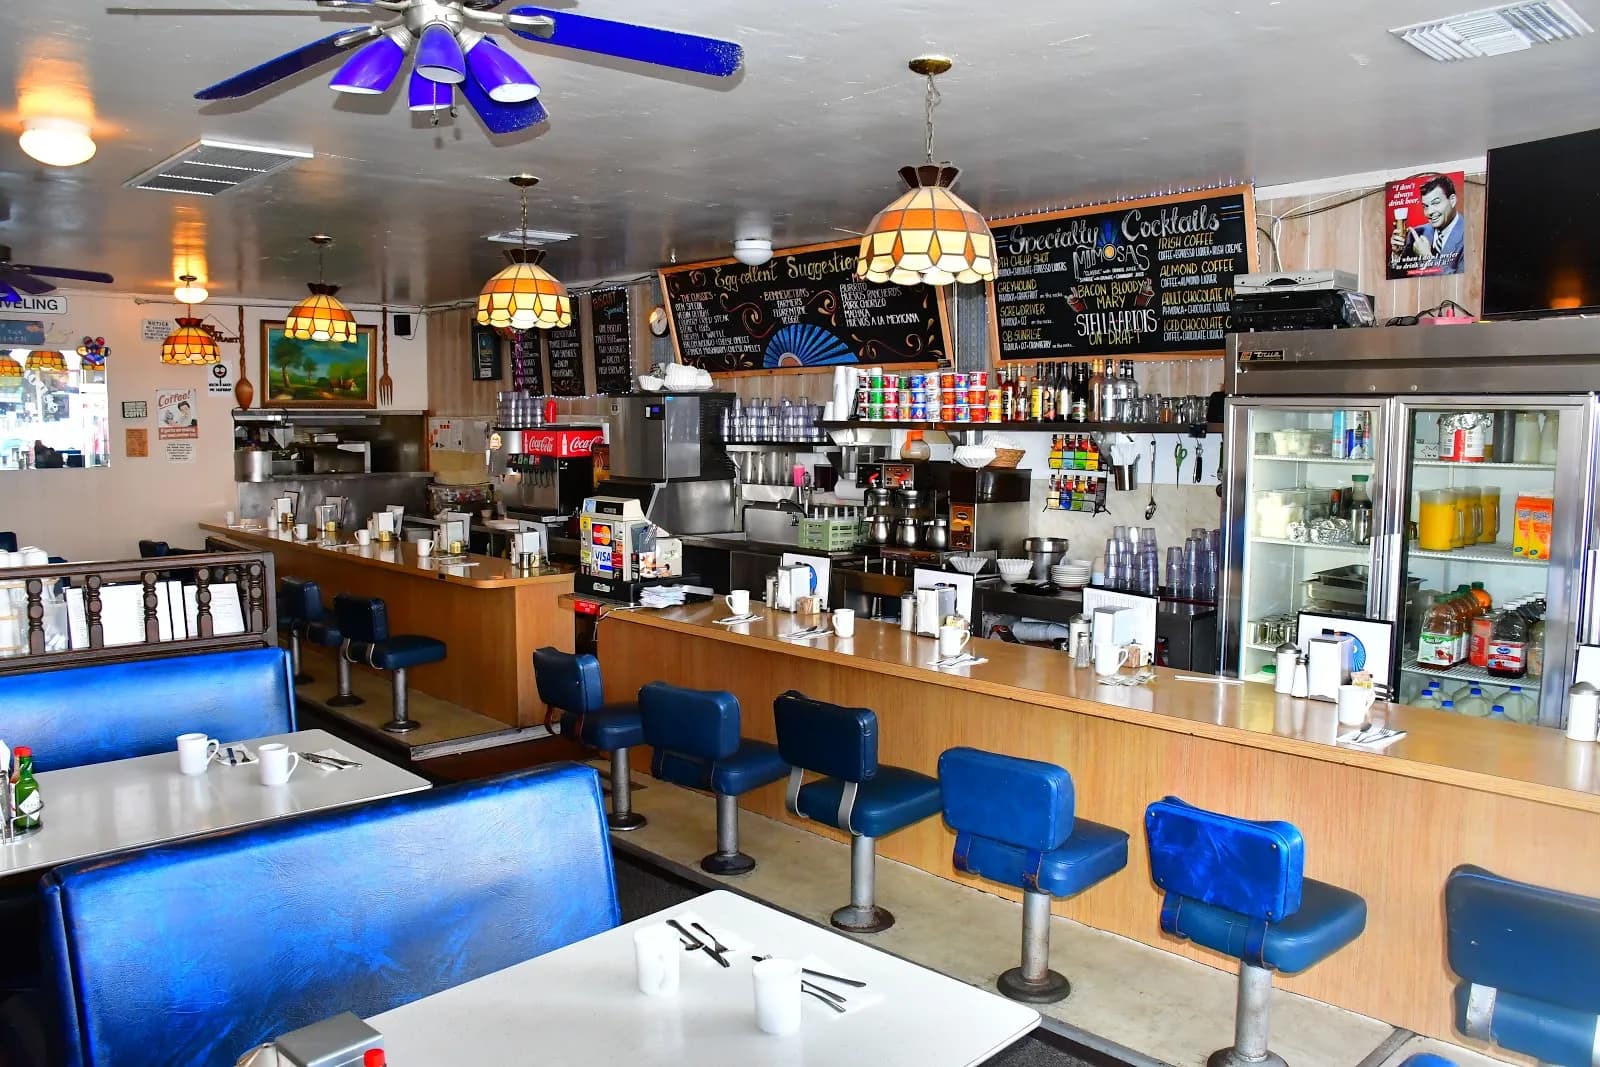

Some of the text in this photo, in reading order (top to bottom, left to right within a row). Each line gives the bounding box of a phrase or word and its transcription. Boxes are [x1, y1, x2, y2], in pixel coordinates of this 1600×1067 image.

[1388, 199, 1404, 207] drink
[1009, 205, 1220, 255] Specialty Cocktails
[1158, 232, 1214, 250] IRISH COFFEE
[786, 251, 858, 280] Suggestion
[1010, 254, 1031, 267] CHEAP
[1033, 252, 1049, 263] SHOT
[1072, 244, 1150, 279] MIMOSAS
[1160, 259, 1234, 277] ALMOND COFFEE
[840, 283, 867, 292] BURRITO
[997, 279, 1037, 292] GREYHOUND
[1078, 280, 1144, 298] BACON BLOODY
[841, 287, 902, 301] HUEVOS RANCHEROS
[1161, 292, 1180, 306] ADULT
[1182, 288, 1222, 304] CHOCOLATE
[843, 298, 886, 310] PORK CHORIZO
[1097, 296, 1126, 309] MARY
[1000, 304, 1046, 317] SCREWDRIVER
[872, 317, 877, 326] A
[877, 316, 885, 325] LA
[886, 313, 920, 325] MEXICANA
[1076, 309, 1157, 337] STELLA ARTOIS
[1163, 319, 1180, 331] ICED
[1181, 316, 1223, 331] CHOCOLATE
[1013, 328, 1042, 341] SUNRISE
[1089, 330, 1140, 346] ON DRAFT
[159, 390, 190, 407] Coffee!
[530, 436, 554, 453] Coca-Cola
[570, 436, 604, 453] Coca-C
[595, 551, 611, 562] VISA
